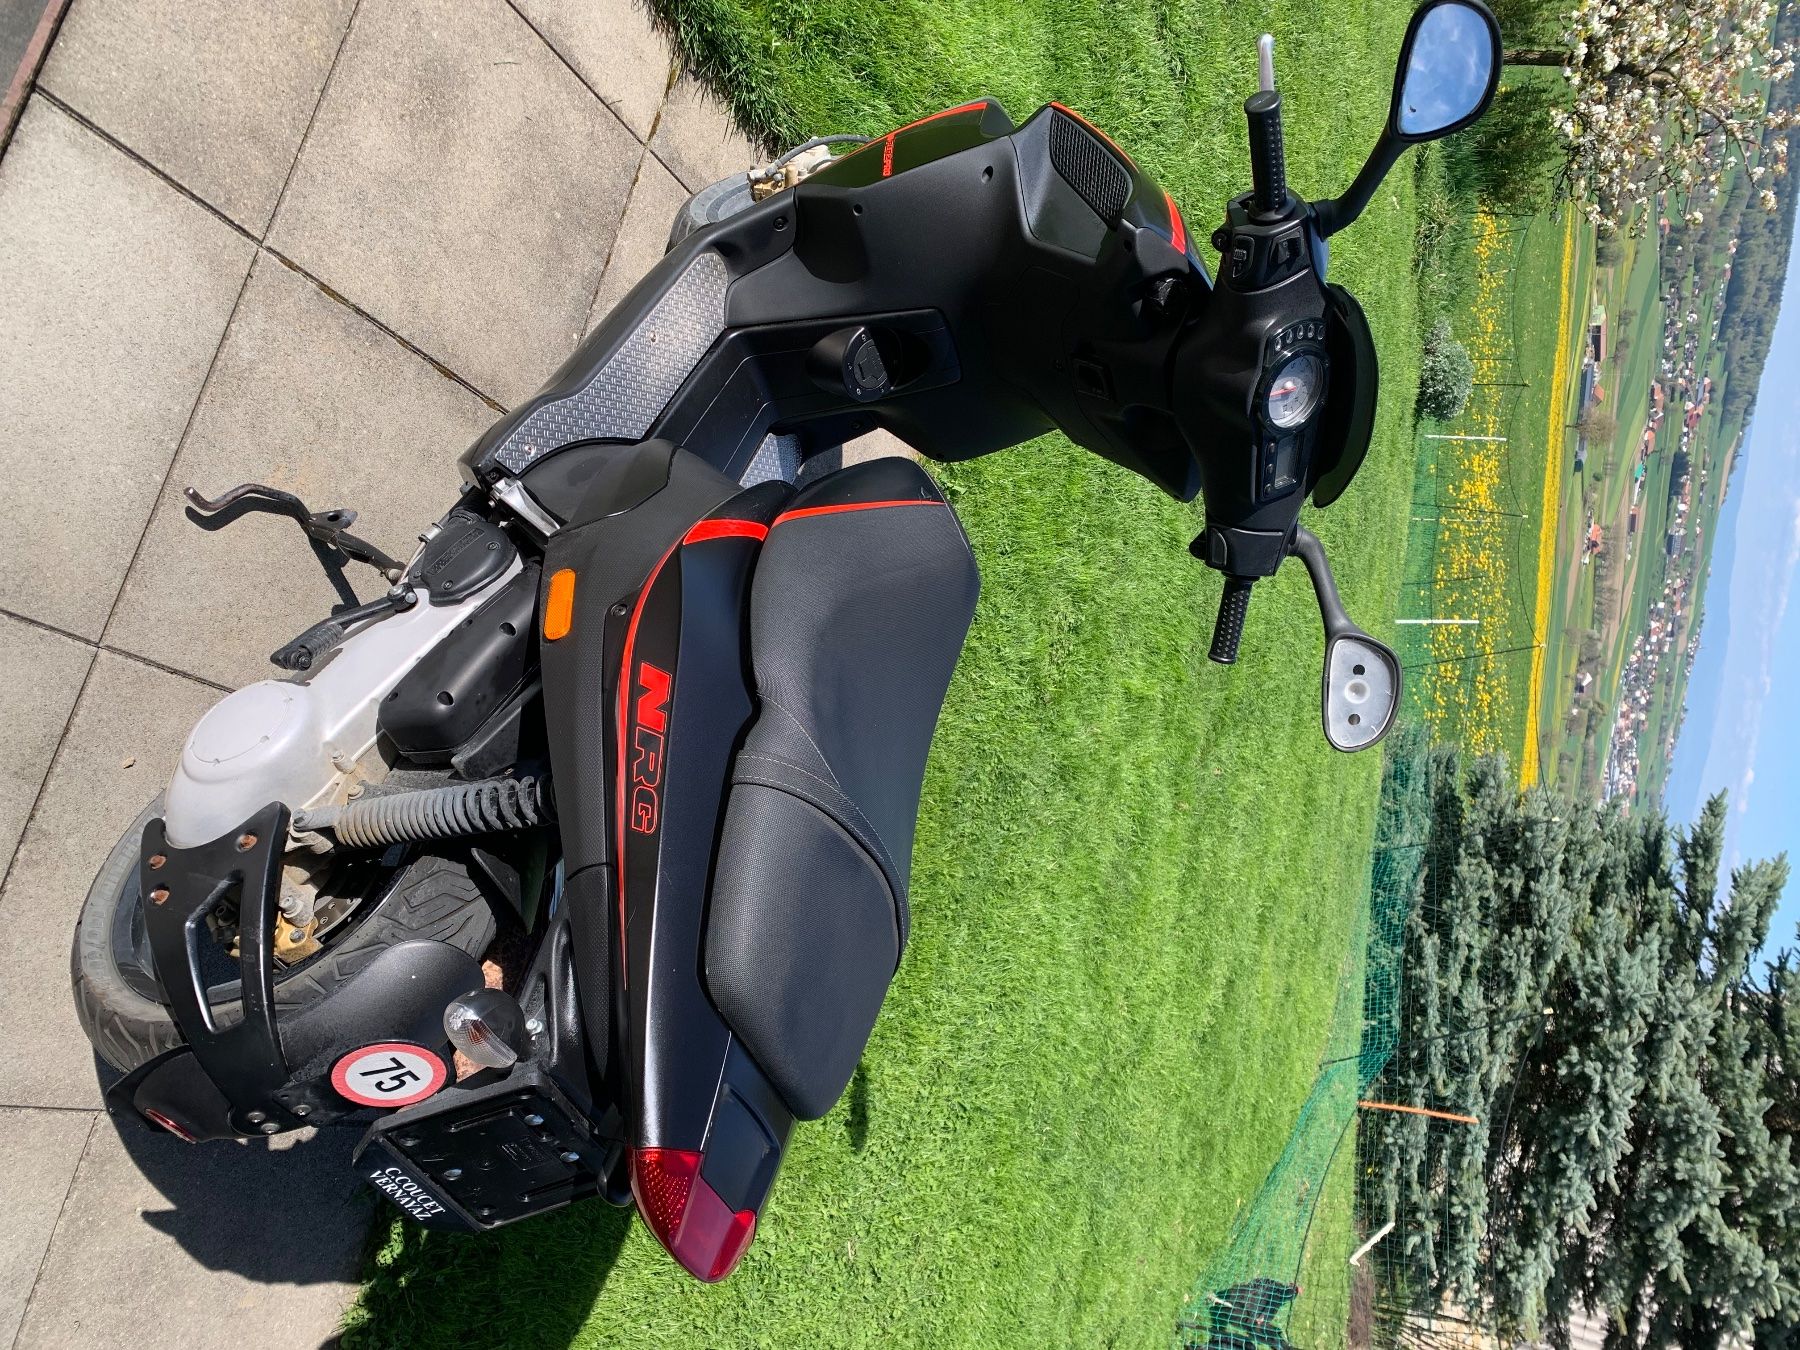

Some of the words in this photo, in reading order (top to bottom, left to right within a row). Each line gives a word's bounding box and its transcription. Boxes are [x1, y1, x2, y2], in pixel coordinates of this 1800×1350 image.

[631, 661, 673, 835] NRG
[360, 1057, 421, 1093] 75
[369, 1170, 432, 1221] VERNAYAZ
[385, 1167, 446, 1214] C.COUCET
